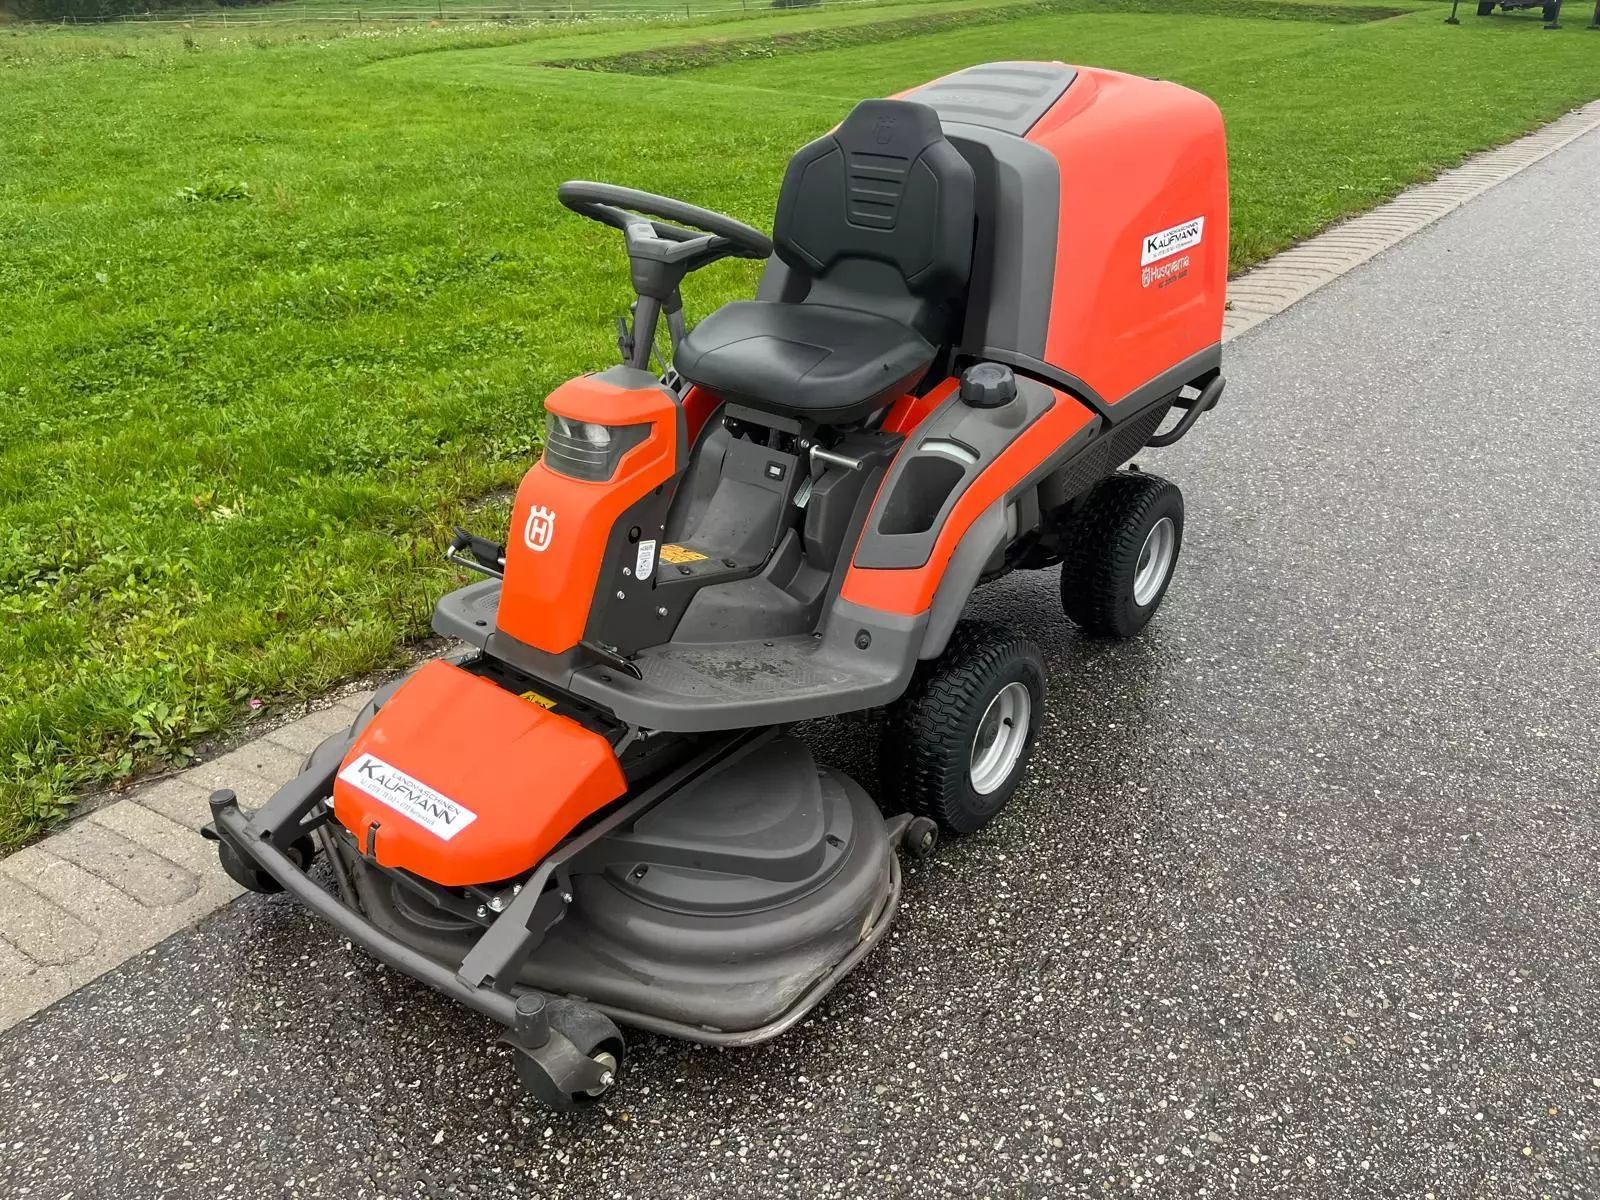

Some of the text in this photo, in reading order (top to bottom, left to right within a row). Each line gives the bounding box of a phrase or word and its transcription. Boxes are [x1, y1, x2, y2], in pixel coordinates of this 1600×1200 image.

[1147, 227, 1199, 254] KAUFMANN
[1151, 255, 1190, 283] Husqvarna
[357, 759, 456, 825] KAUFMANN
